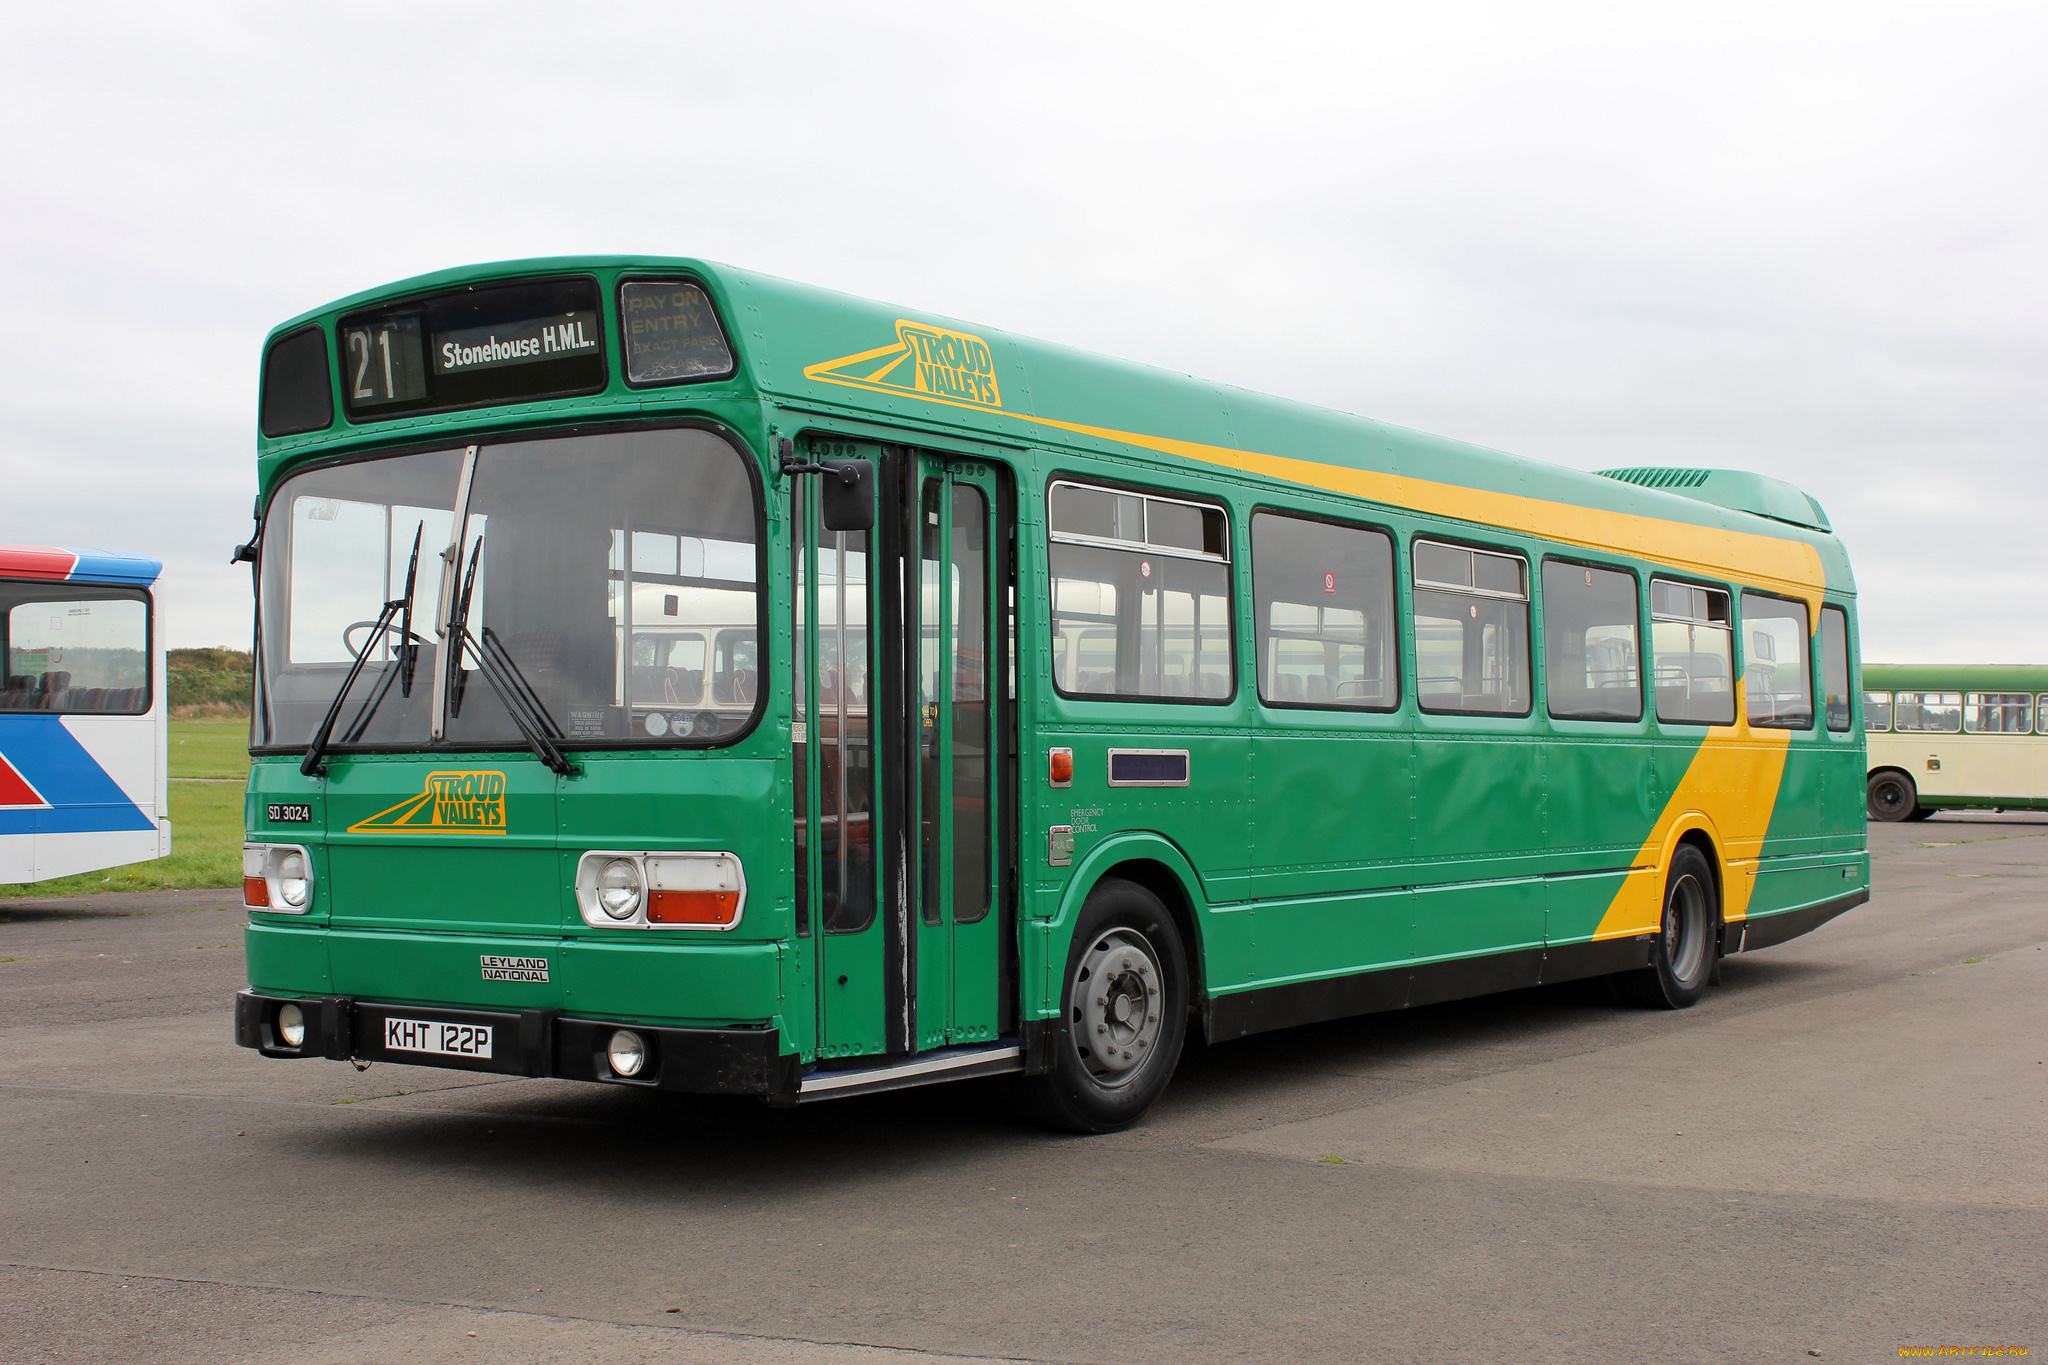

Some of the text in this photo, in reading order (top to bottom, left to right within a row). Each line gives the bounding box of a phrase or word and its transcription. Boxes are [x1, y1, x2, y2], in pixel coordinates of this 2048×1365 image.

[629, 290, 699, 312] PAY ON
[631, 313, 700, 334] ENTRY
[442, 321, 595, 368] Stonehouse H.M.L.
[683, 335, 718, 349] FARE
[350, 330, 394, 398] 21
[919, 362, 996, 404] VALLEYS
[570, 711, 605, 719] WARNING
[430, 774, 502, 801] STROUD
[268, 805, 309, 821] SD 3024
[438, 802, 501, 825] VALLEYS
[1070, 808, 1105, 817] EMERGENCY
[1071, 817, 1090, 825] DOOR
[1071, 824, 1098, 834] CONTROL
[1051, 840, 1071, 850] PULL
[482, 956, 547, 969] LEYLAND
[484, 969, 548, 982] NATIONAL
[388, 1020, 489, 1055] KHT 122P
